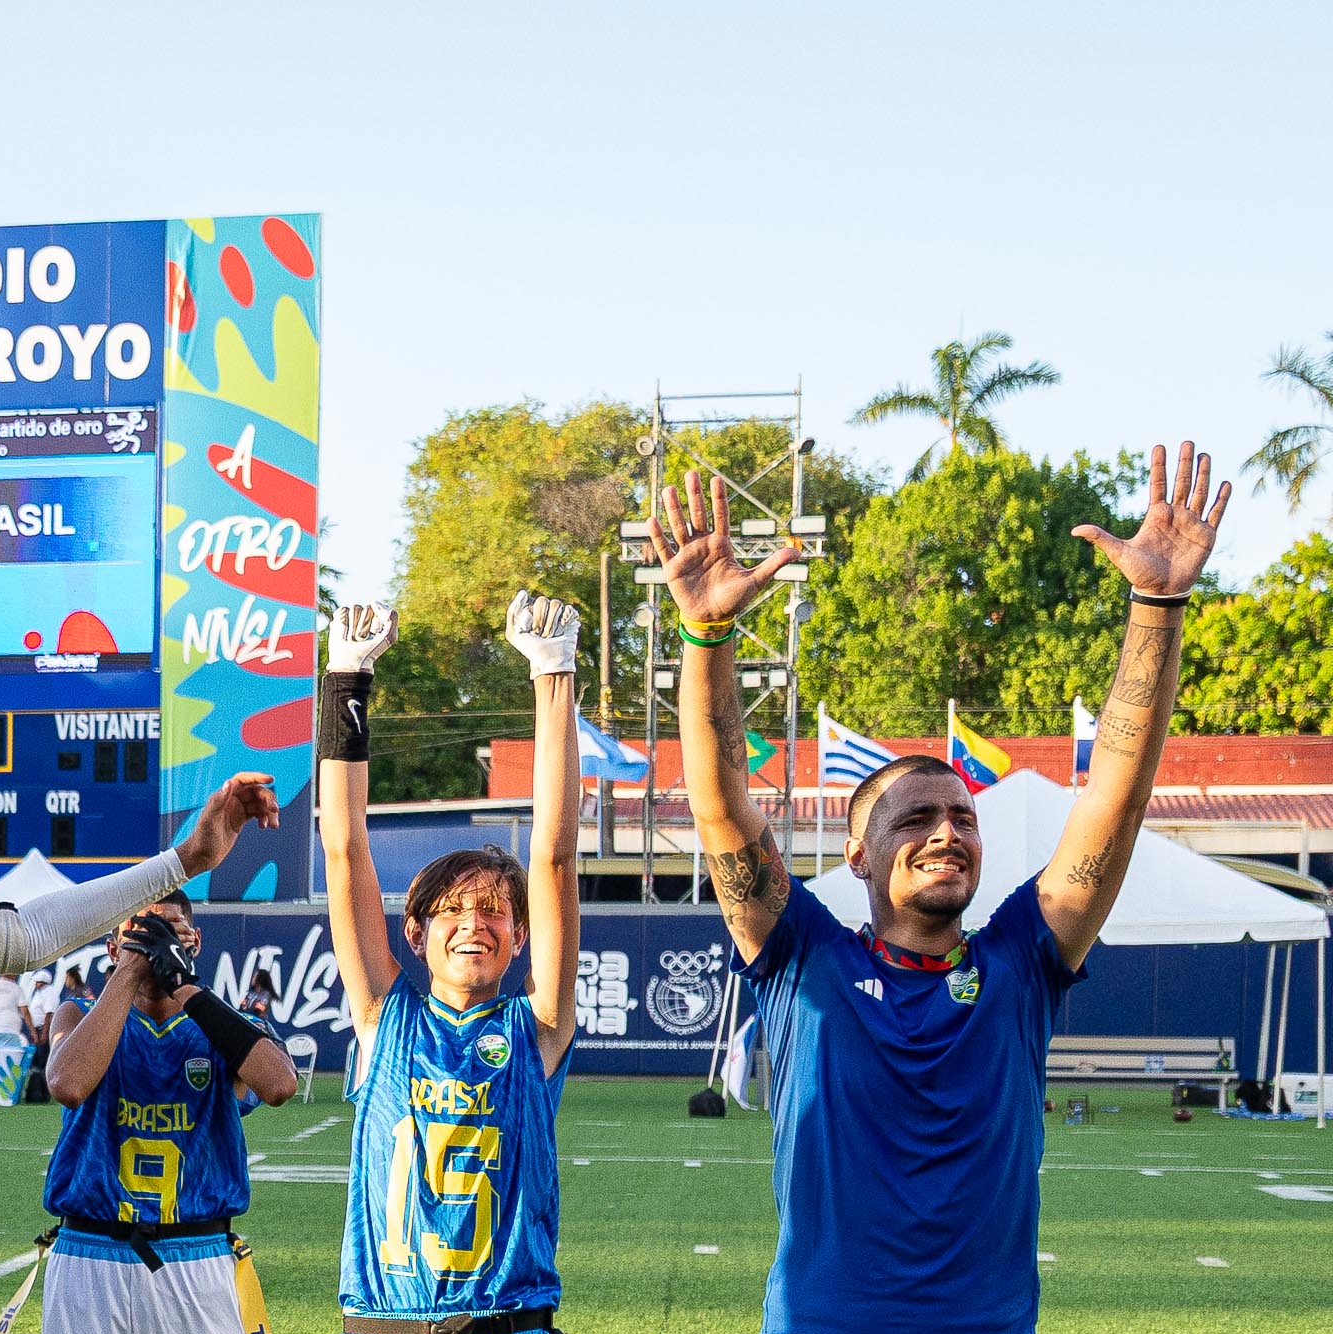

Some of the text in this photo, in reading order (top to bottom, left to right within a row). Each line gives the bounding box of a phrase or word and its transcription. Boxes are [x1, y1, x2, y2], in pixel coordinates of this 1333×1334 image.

[48, 417, 71, 436] de
[73, 420, 103, 435] oro
[216, 423, 256, 489] A
[178, 515, 301, 575] OTRO
[182, 594, 294, 665] NIVEL
[55, 712, 160, 740] VISITANTE
[45, 790, 80, 814] QTR
[116, 1097, 196, 1132] BRASIL
[118, 1136, 186, 1224] 9
[380, 1115, 503, 1281] 15
